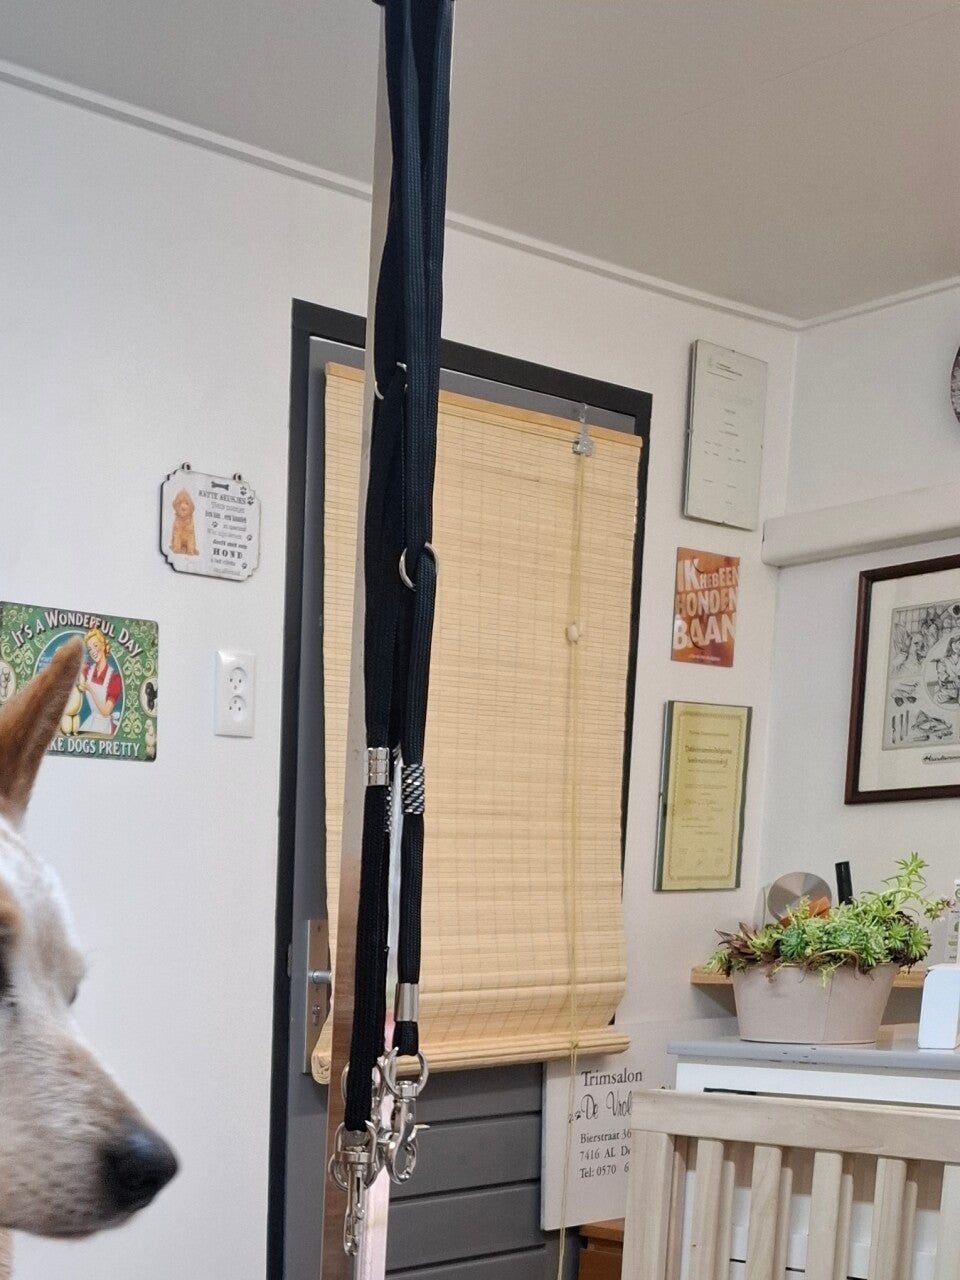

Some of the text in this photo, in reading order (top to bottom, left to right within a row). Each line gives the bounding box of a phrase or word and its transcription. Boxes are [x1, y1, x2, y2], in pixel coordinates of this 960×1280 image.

[677, 558, 740, 592] IK HEB EEN
[676, 587, 738, 617] HONDEN
[36, 619, 44, 634] A
[45, 610, 114, 636] WONDERFUL
[118, 628, 143, 656] DAY
[673, 613, 736, 649] BAAN
[67, 739, 97, 754] DOGS
[99, 741, 141, 757] PRETTY
[580, 1067, 643, 1087] Trimsalon
[581, 1094, 599, 1119] De
[580, 1129, 632, 1144] Bierstraat 36
[579, 1149, 600, 1161] 7416
[604, 1147, 616, 1158] AL
[579, 1166, 595, 1179] Tel:
[596, 1163, 617, 1176] 0570
